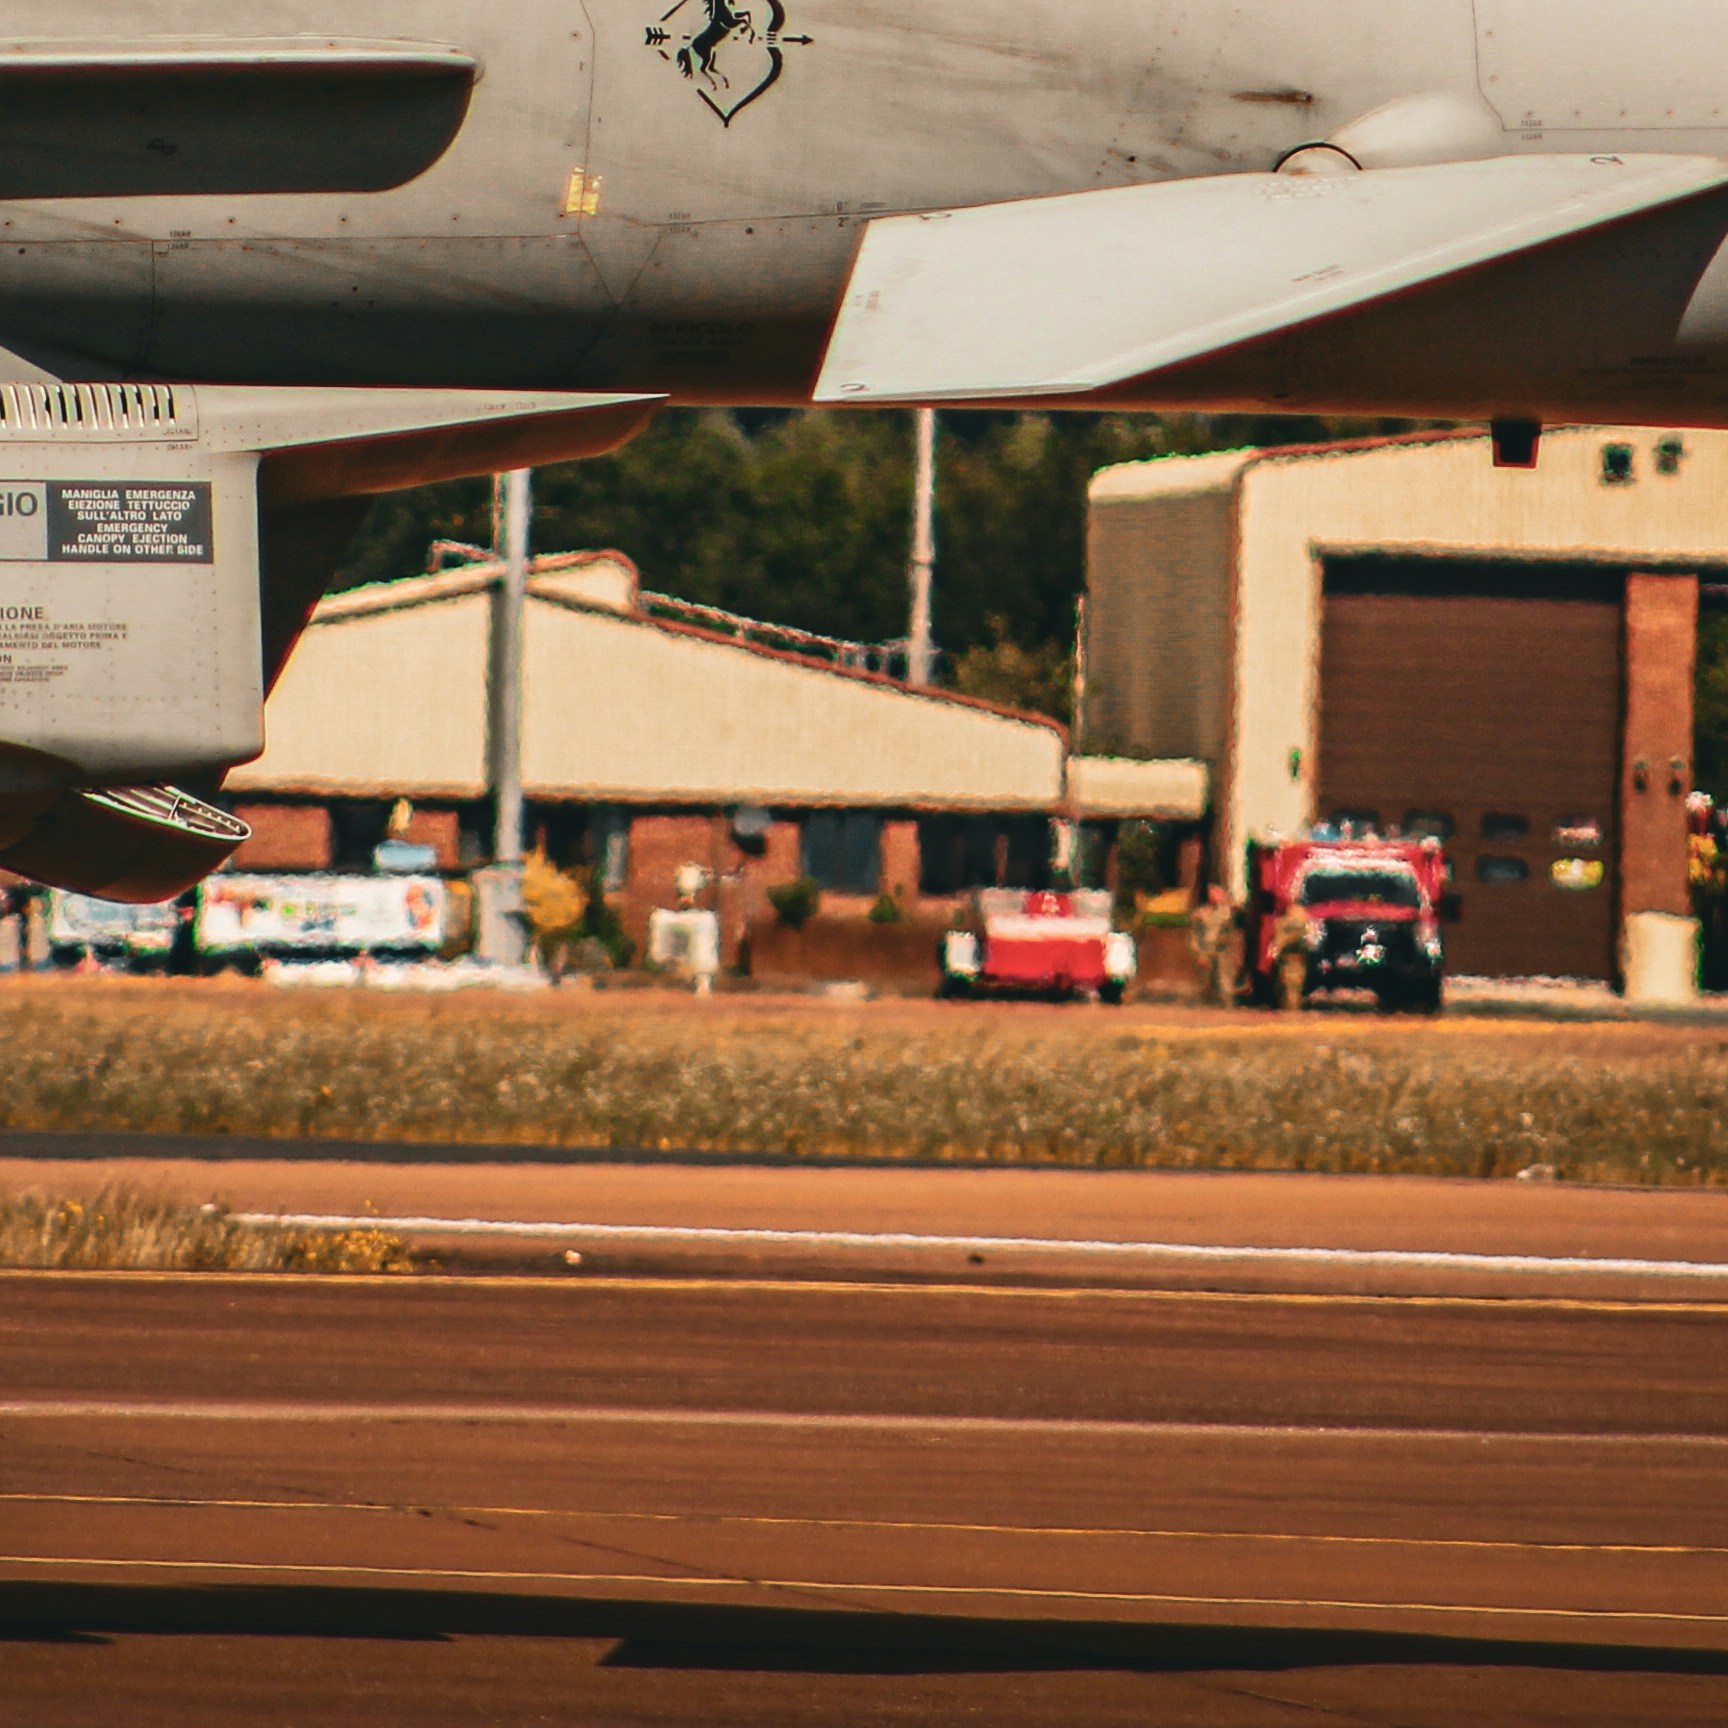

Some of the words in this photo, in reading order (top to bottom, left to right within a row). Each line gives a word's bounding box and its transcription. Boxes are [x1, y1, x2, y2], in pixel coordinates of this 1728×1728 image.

[61, 489, 119, 499] MANIGLIA
[125, 490, 196, 500] EMERGENZA
[68, 500, 120, 510] EIEZIONE
[127, 500, 190, 511] TETTUCCIO
[77, 510, 147, 521] SULL'ALTRO
[152, 511, 182, 521] LATO
[96, 523, 168, 533] EMERGENCY
[77, 533, 125, 544] CANOPY
[132, 534, 187, 544] EJECTION
[61, 544, 109, 554] HANDLE
[113, 544, 131, 555] ON
[134, 545, 173, 555] OTHER
[177, 545, 204, 555] SIDE
[5, 623, 16, 631] LA
